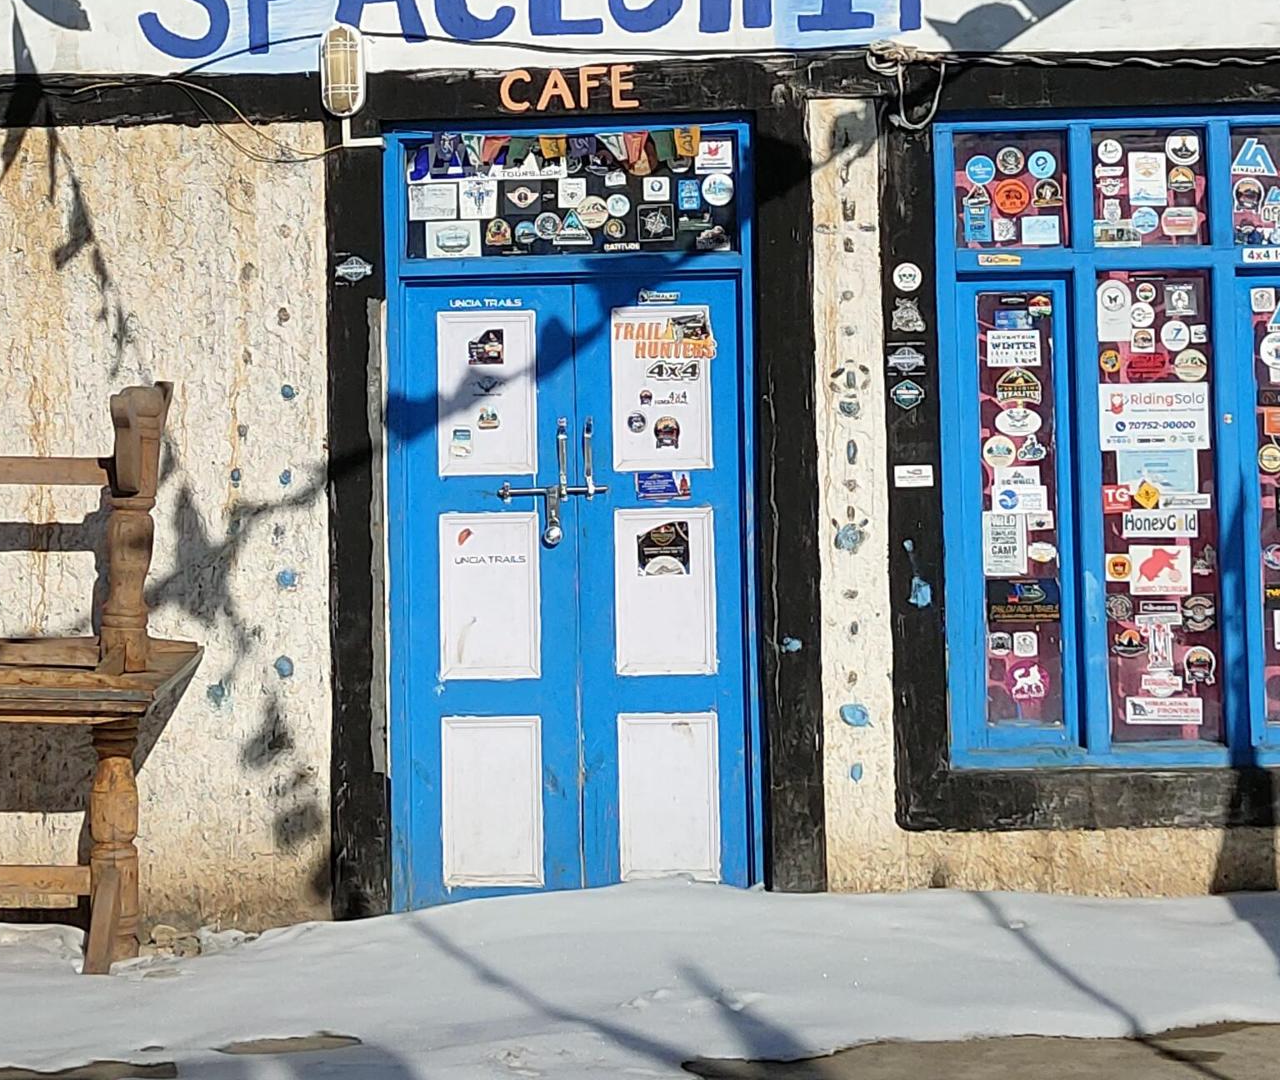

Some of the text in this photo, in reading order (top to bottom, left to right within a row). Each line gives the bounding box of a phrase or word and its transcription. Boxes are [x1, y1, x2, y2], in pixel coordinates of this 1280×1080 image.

[499, 65, 639, 112] CAFE
[1247, 249, 1271, 260] 4x4
[449, 298, 522, 308] UNCIA TRAILS
[614, 322, 663, 340] TRAIL
[635, 341, 716, 359] HUNTERS
[991, 341, 1037, 350] WINTER
[647, 361, 699, 379] 4x4
[1130, 392, 1205, 407] RidingSolo
[1128, 420, 1196, 430] 70752-00000
[1104, 488, 1129, 503] TG
[991, 545, 1017, 555] CAMP
[454, 555, 526, 565] UNCIA TRAILS
